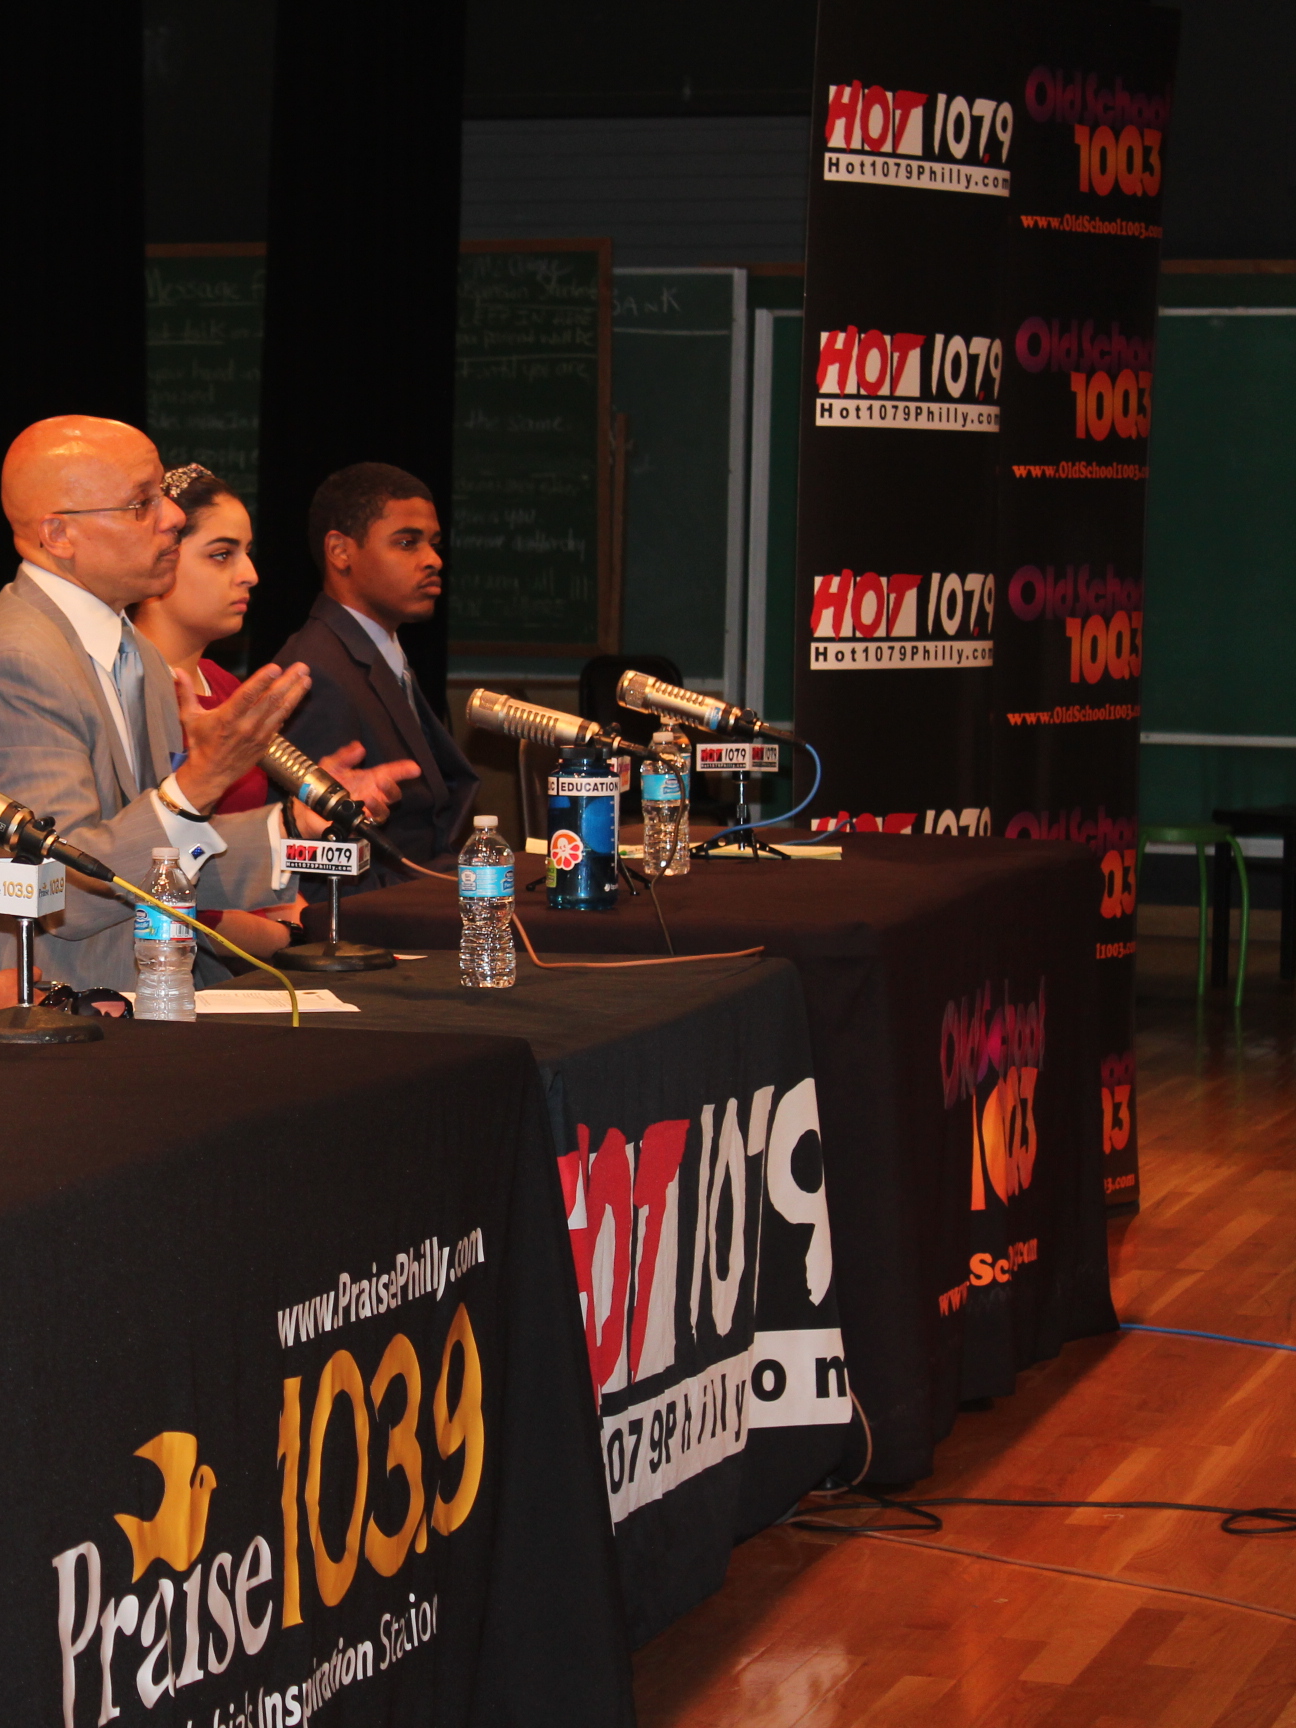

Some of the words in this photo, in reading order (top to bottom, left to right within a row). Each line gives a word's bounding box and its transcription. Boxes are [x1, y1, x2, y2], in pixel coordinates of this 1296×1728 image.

[824, 79, 930, 153] HOT
[816, 325, 927, 397] HOT
[810, 568, 924, 641] HOT
[560, 782, 618, 792] EDUCATION
[286, 843, 319, 862] HOT
[2, 880, 35, 900] 103.9
[277, 1226, 485, 1349] www.PraisePhilly.com
[51, 1534, 273, 1728] Praise
[276, 1301, 487, 1631] 103.9
